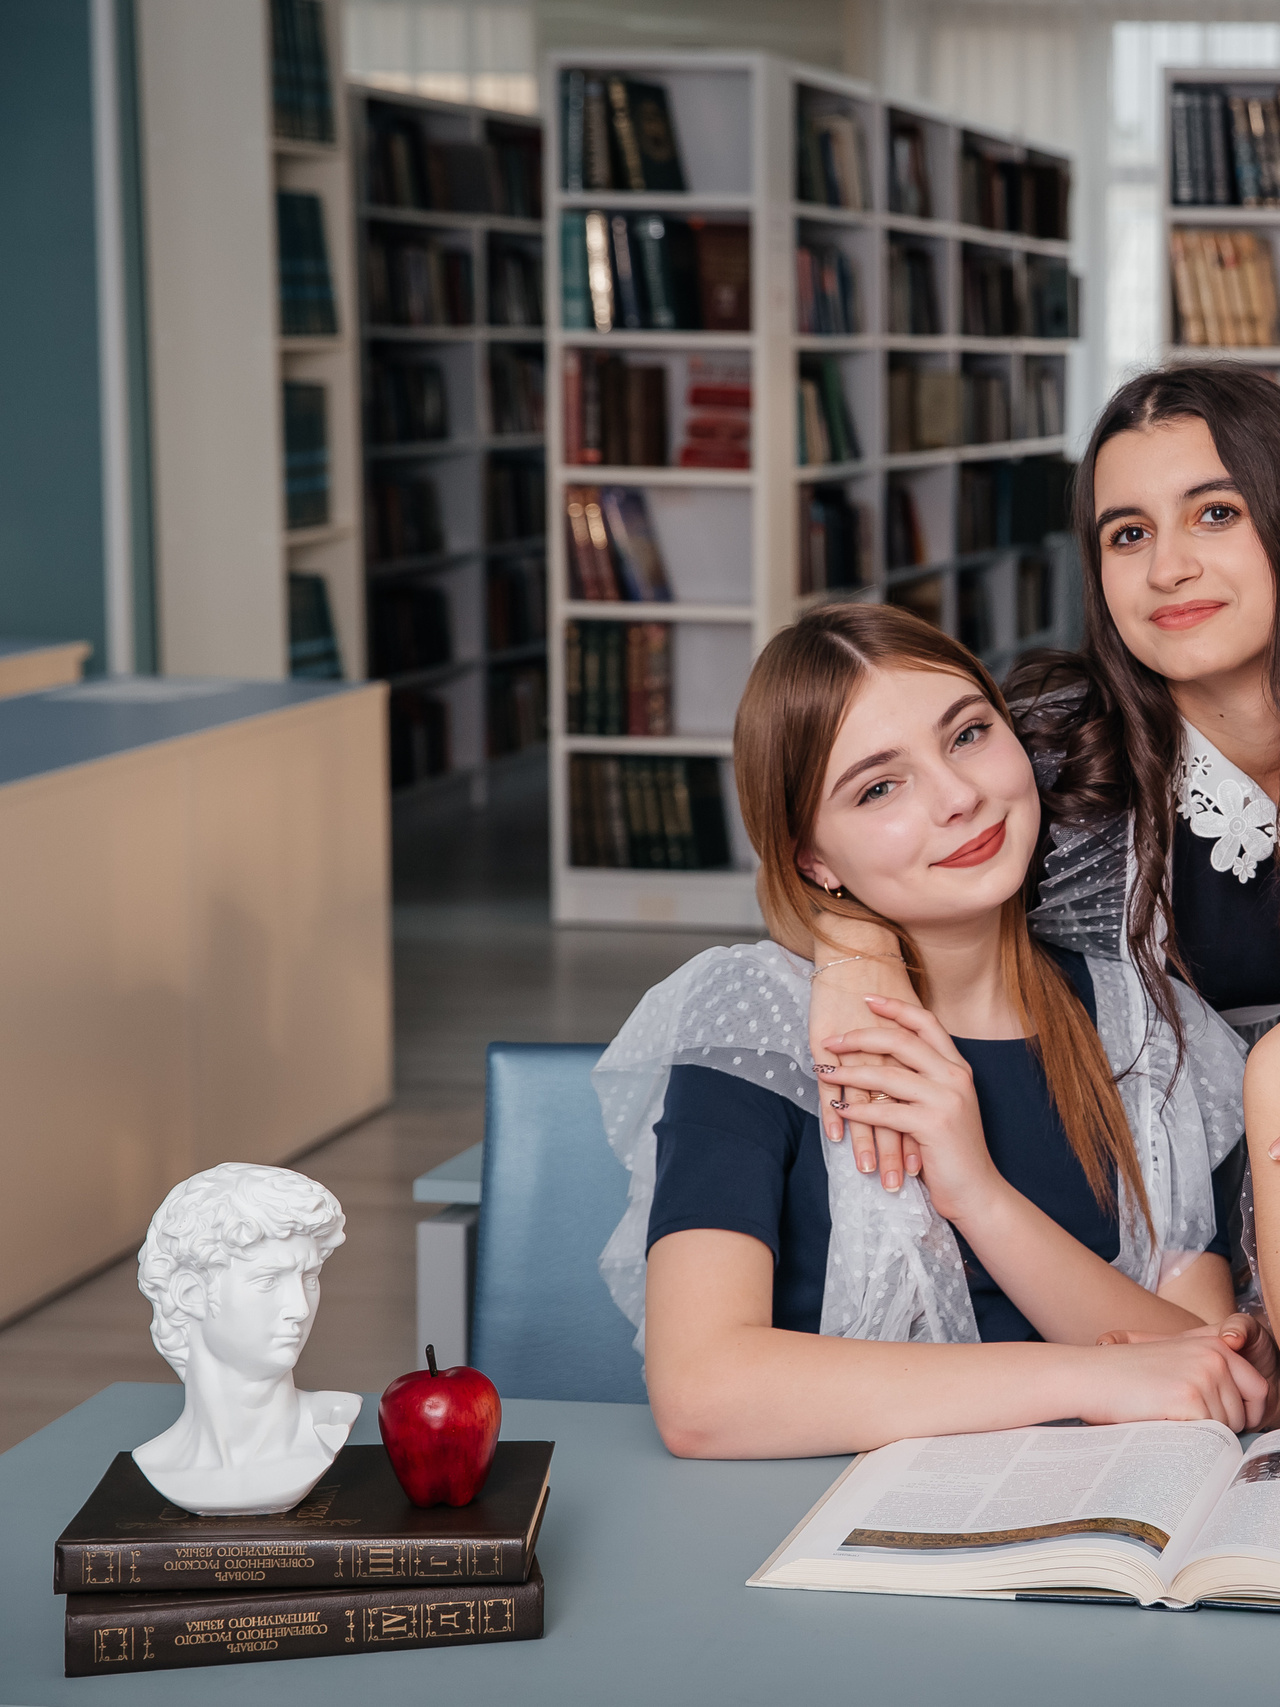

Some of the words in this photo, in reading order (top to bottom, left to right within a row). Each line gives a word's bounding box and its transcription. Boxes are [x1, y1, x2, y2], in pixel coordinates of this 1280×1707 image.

[175, 1547, 213, 1558] ЯЗЫКА
[216, 1546, 307, 1557] ЛИТЕРАТУРНОГО
[164, 1559, 220, 1571] РУССКОГО
[224, 1558, 315, 1569] СОВРЕМЕННОГО
[369, 1548, 394, 1574] III
[215, 1571, 266, 1582] СЛОВАРЬ
[186, 1619, 225, 1632] ЯЗЫКА
[228, 1611, 321, 1629] ЛИТЕРАТУРНОГО
[382, 1611, 407, 1635] IV
[174, 1631, 232, 1646] РУССКОГО
[236, 1624, 328, 1641] СОВРЕМЕННОГО
[226, 1640, 279, 1653] СЛОВАРЬ
